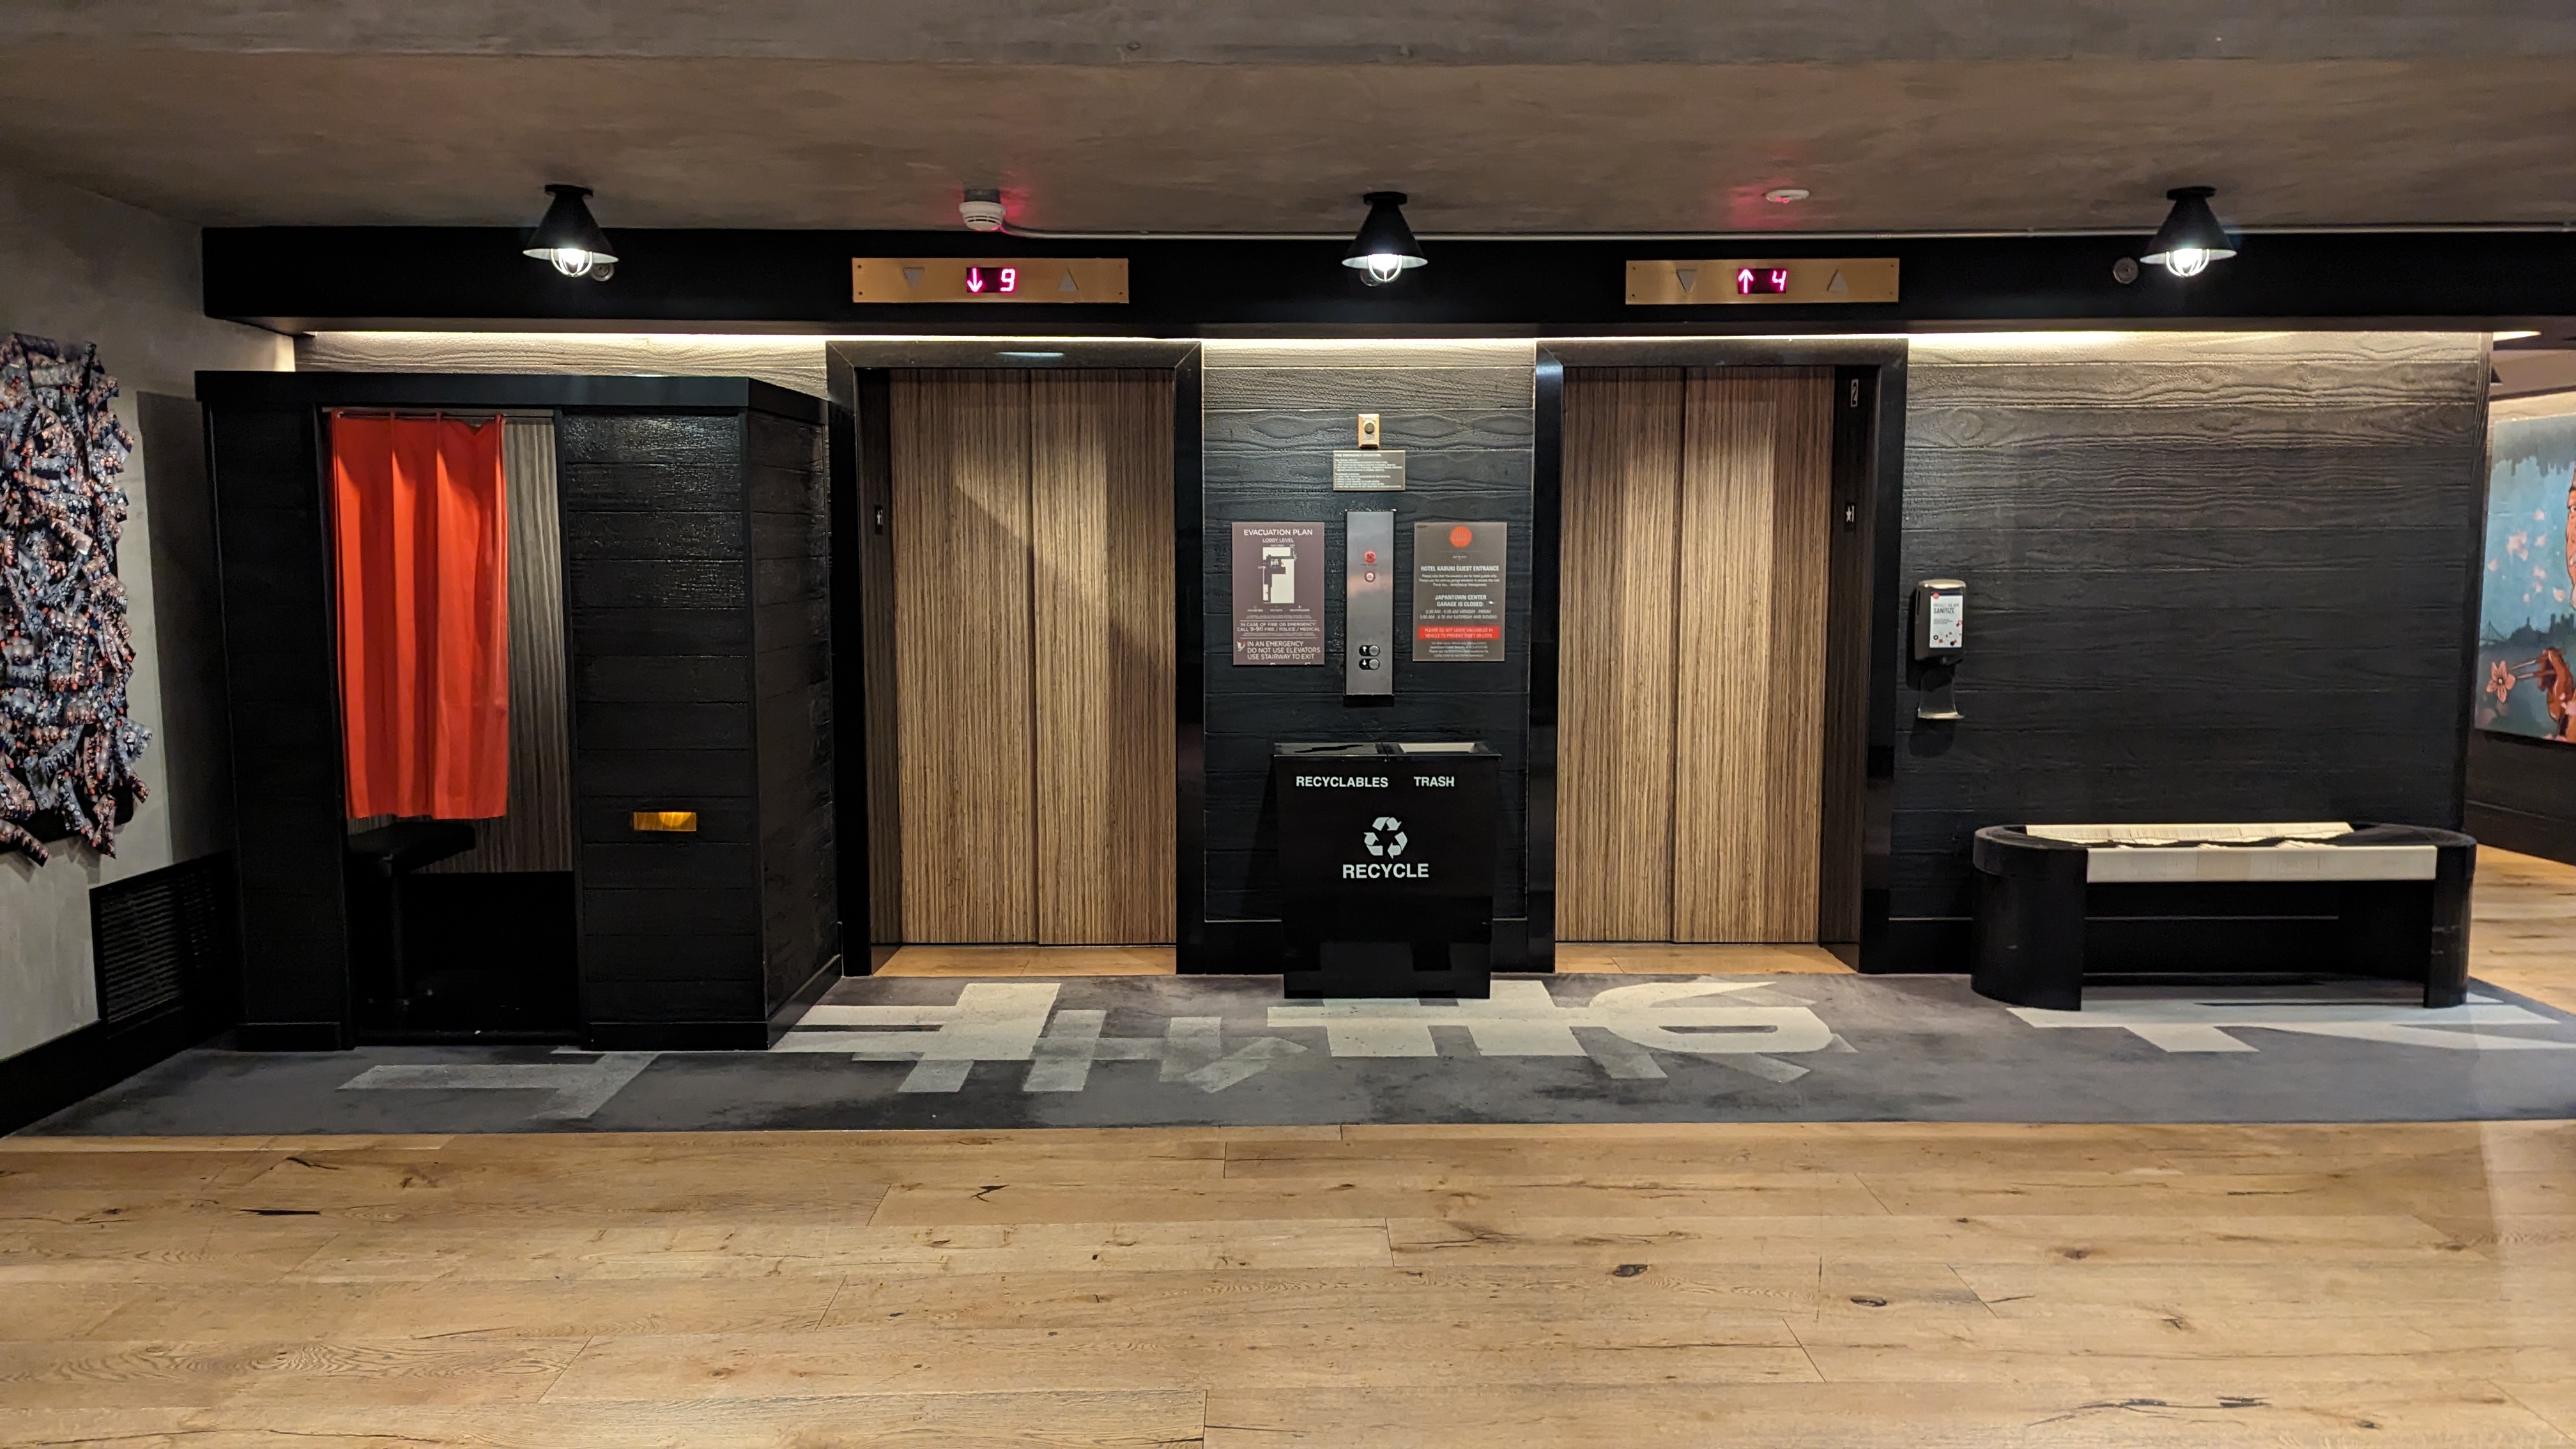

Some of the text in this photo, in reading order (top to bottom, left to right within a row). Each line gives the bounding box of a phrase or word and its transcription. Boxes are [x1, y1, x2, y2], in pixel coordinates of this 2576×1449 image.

[1000, 268, 1015, 292] 9
[1772, 270, 1786, 291] 4
[1851, 381, 1857, 406] 2
[1296, 776, 1388, 788] RECYCLABLES
[1414, 776, 1455, 786] TRASH
[1343, 864, 1429, 878] RECYCLE
